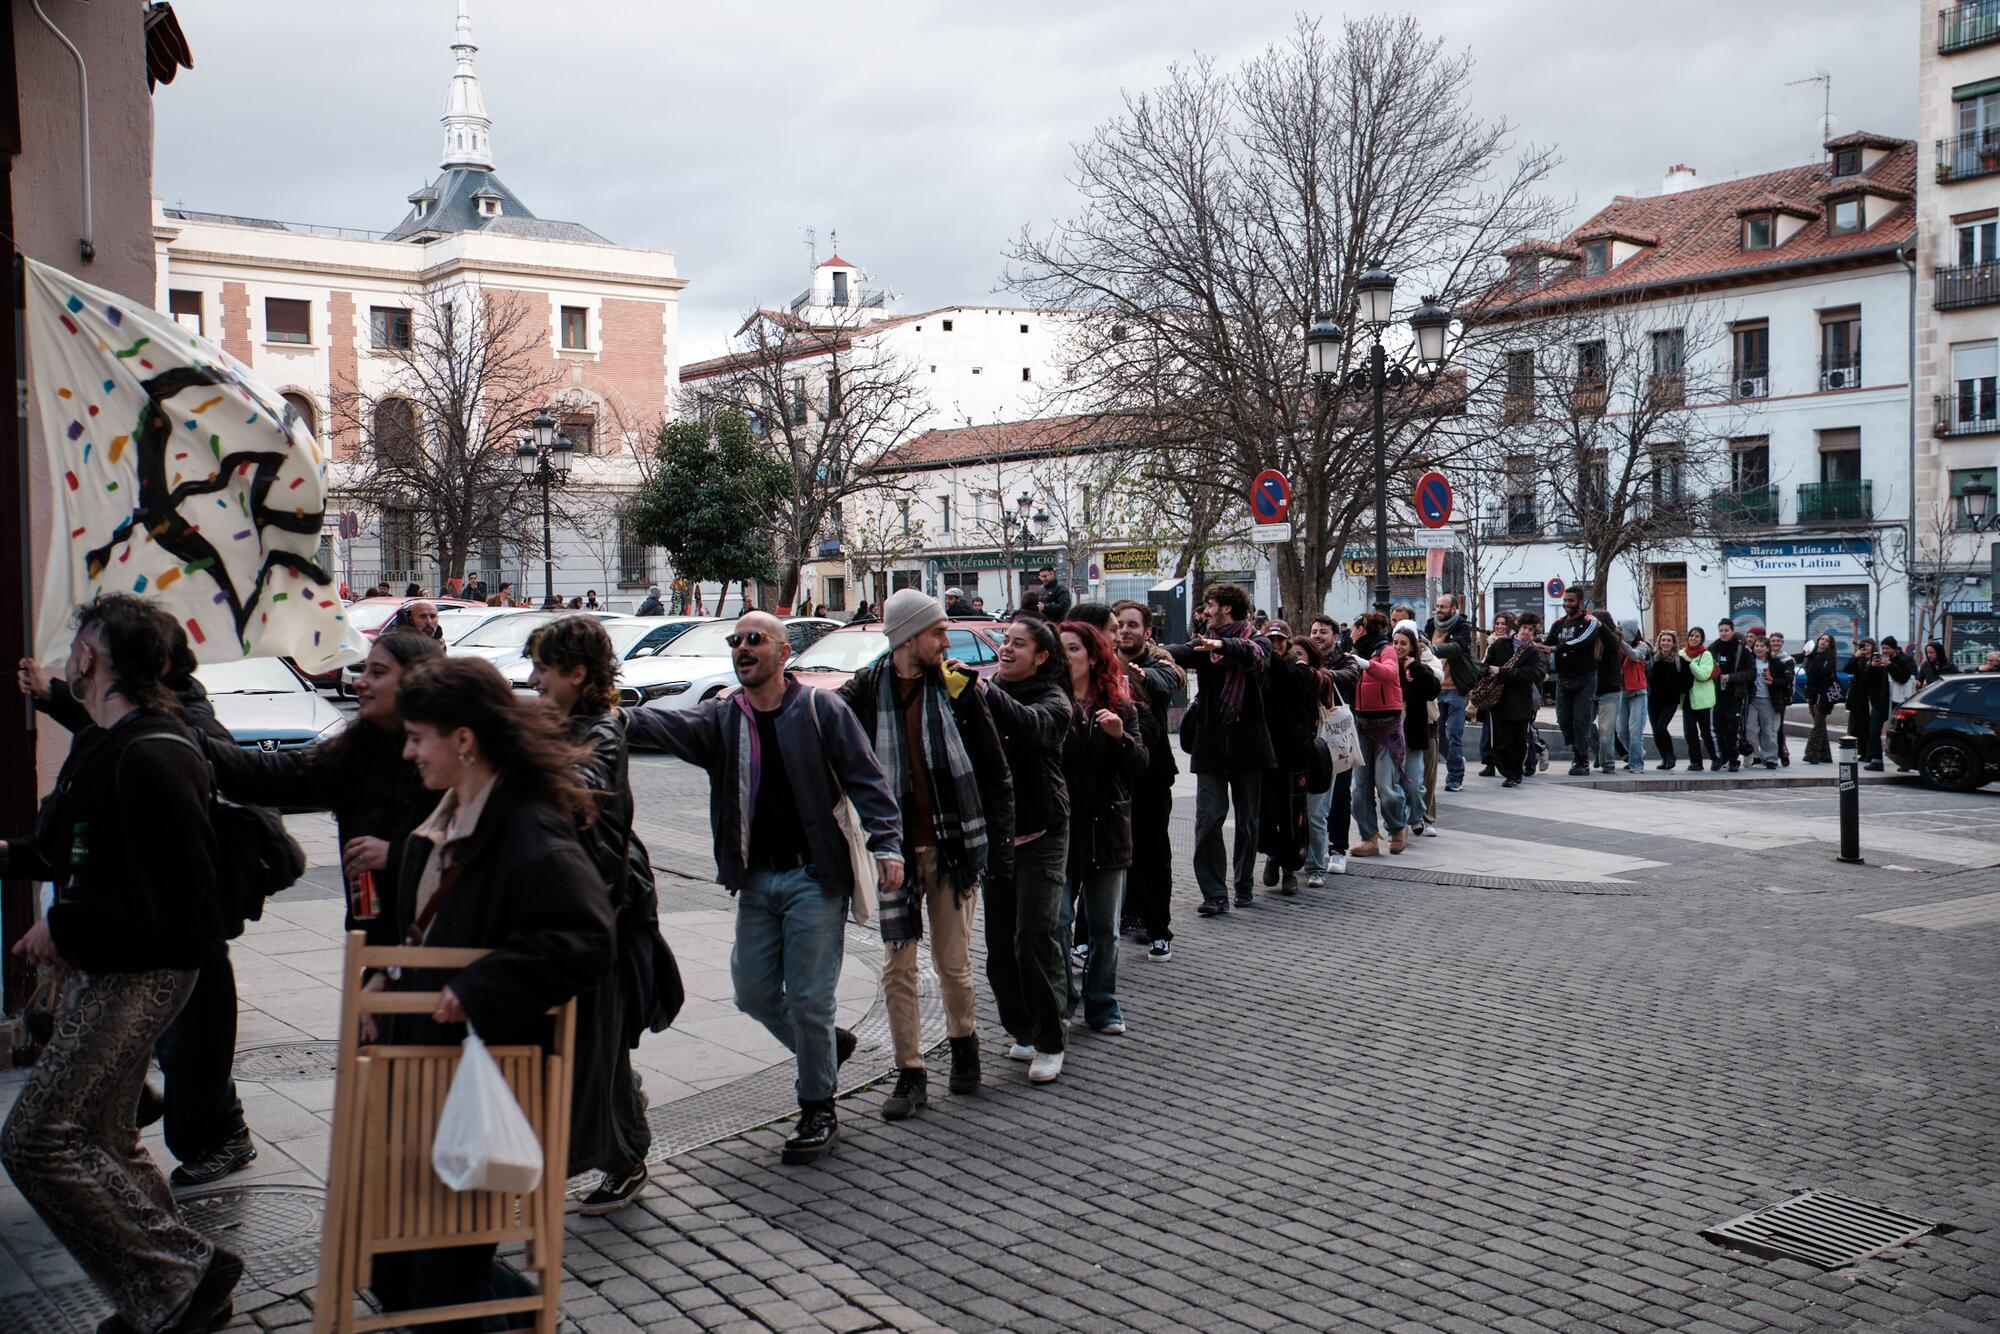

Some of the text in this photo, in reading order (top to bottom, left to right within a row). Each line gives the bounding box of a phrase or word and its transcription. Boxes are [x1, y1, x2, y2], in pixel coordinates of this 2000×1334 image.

[1750, 546, 1784, 555] Marcos
[1013, 556, 1054, 565] PAACIO
[1754, 558, 1841, 569] Marcos Latina
[1176, 586, 1184, 599] P
